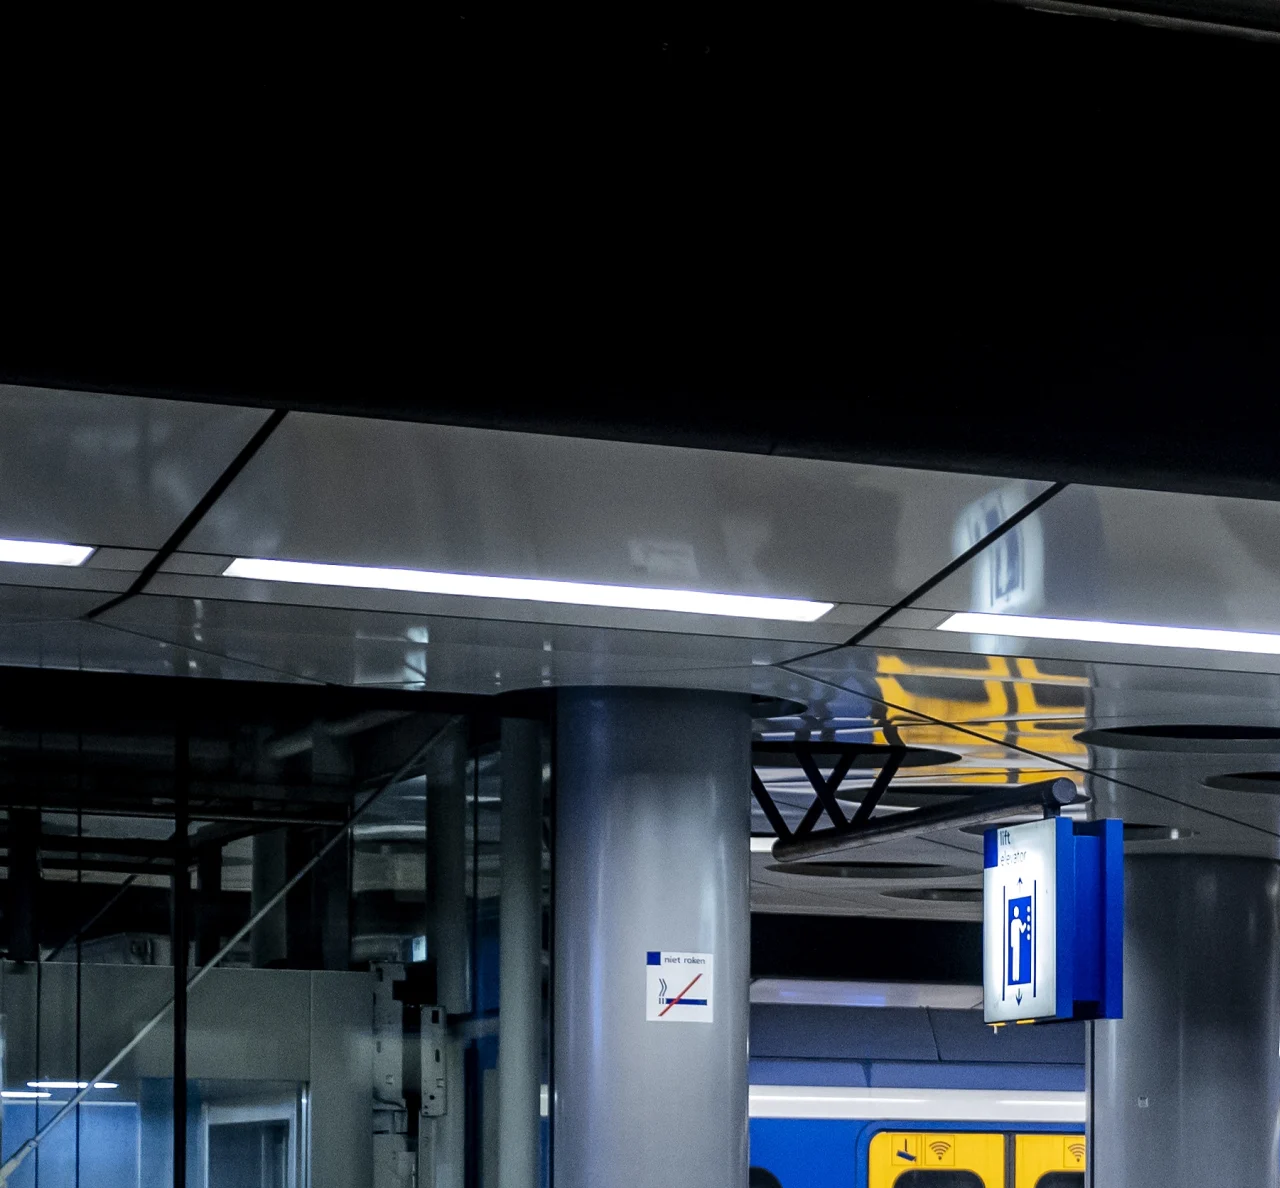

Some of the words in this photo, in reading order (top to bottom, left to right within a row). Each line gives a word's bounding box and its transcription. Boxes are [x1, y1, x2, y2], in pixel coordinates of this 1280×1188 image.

[1000, 829, 1011, 846] lift
[664, 956, 681, 964] niet
[684, 957, 706, 965] roken
